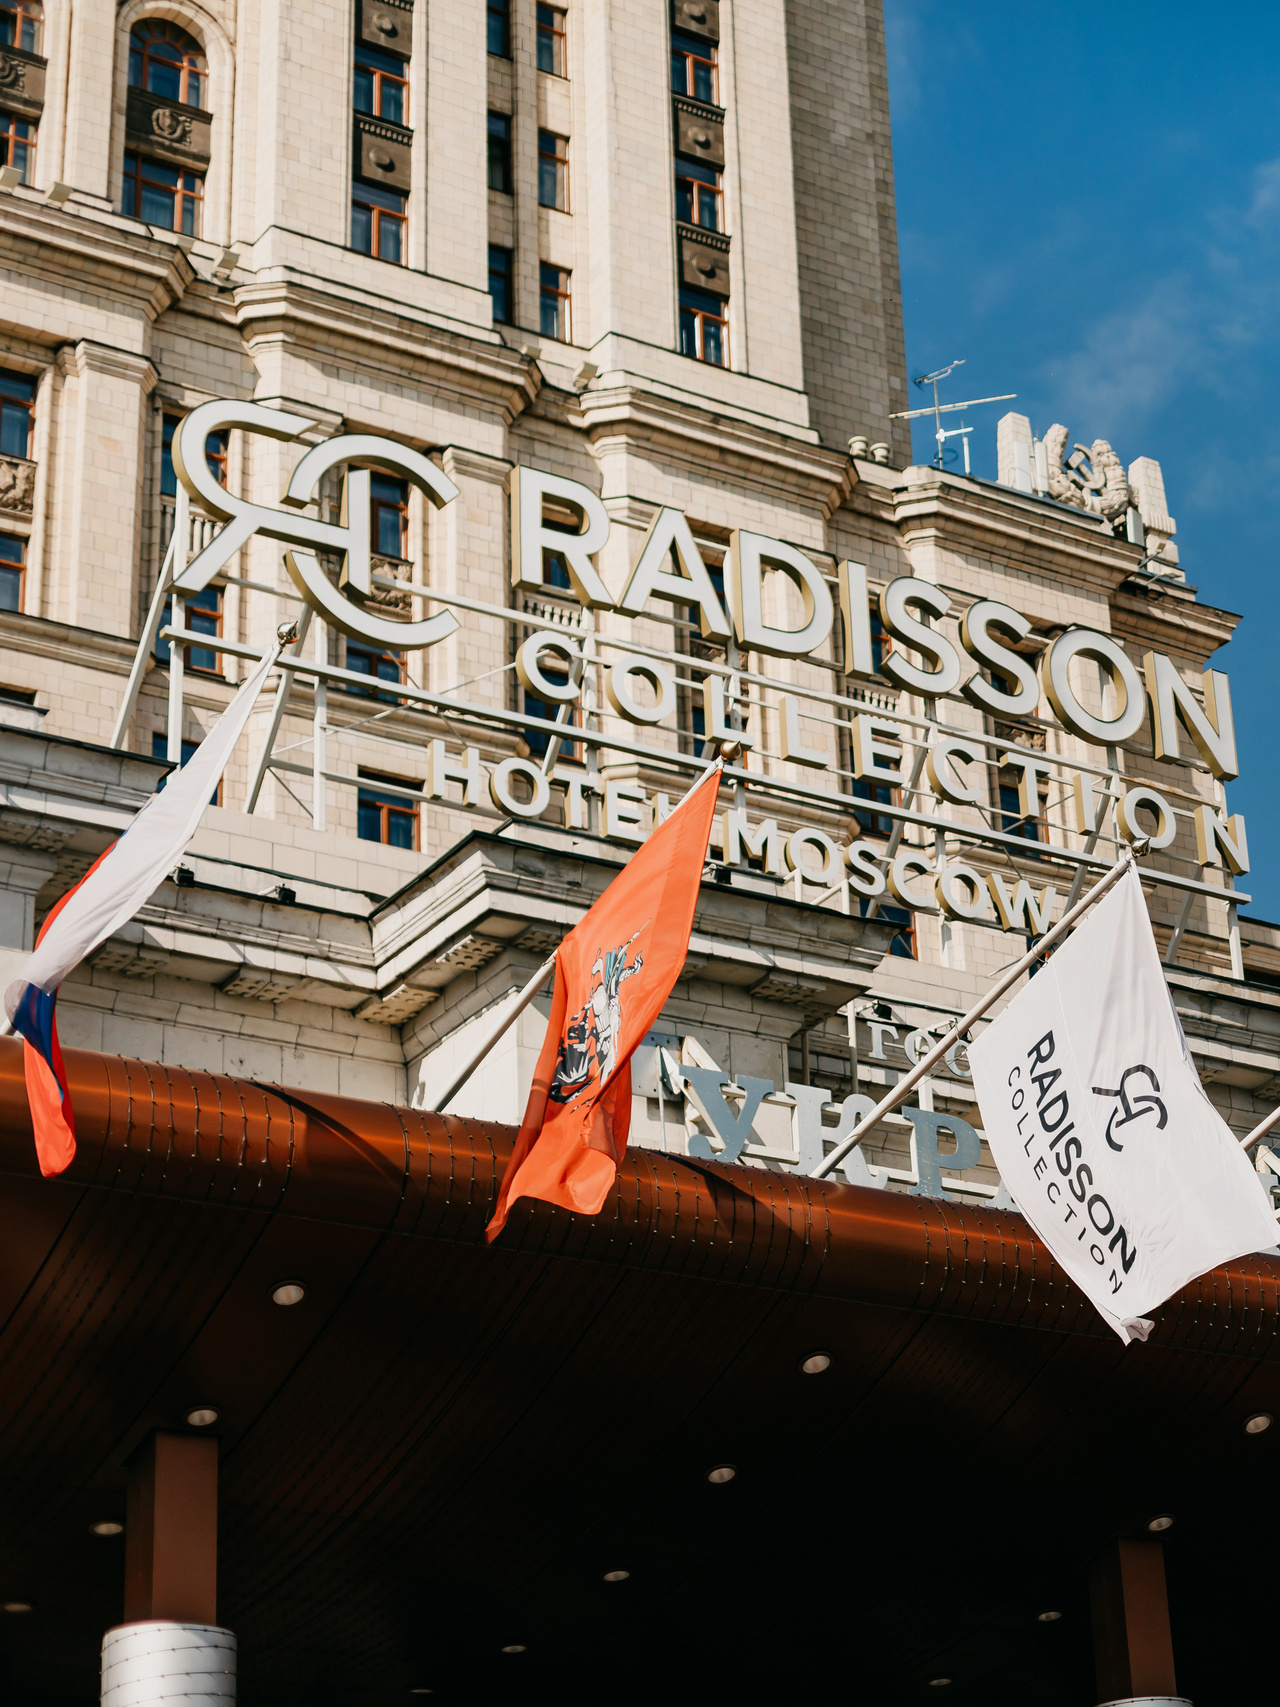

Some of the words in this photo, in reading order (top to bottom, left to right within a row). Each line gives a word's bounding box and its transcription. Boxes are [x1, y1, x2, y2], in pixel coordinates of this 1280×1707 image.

[510, 464, 1239, 781] RADISSON
[516, 630, 1250, 876] COLLECTION
[722, 809, 1056, 935] MOSCOW
[1008, 1065, 1123, 1295] COLLECTION
[1027, 1029, 1137, 1275] RADISSON
